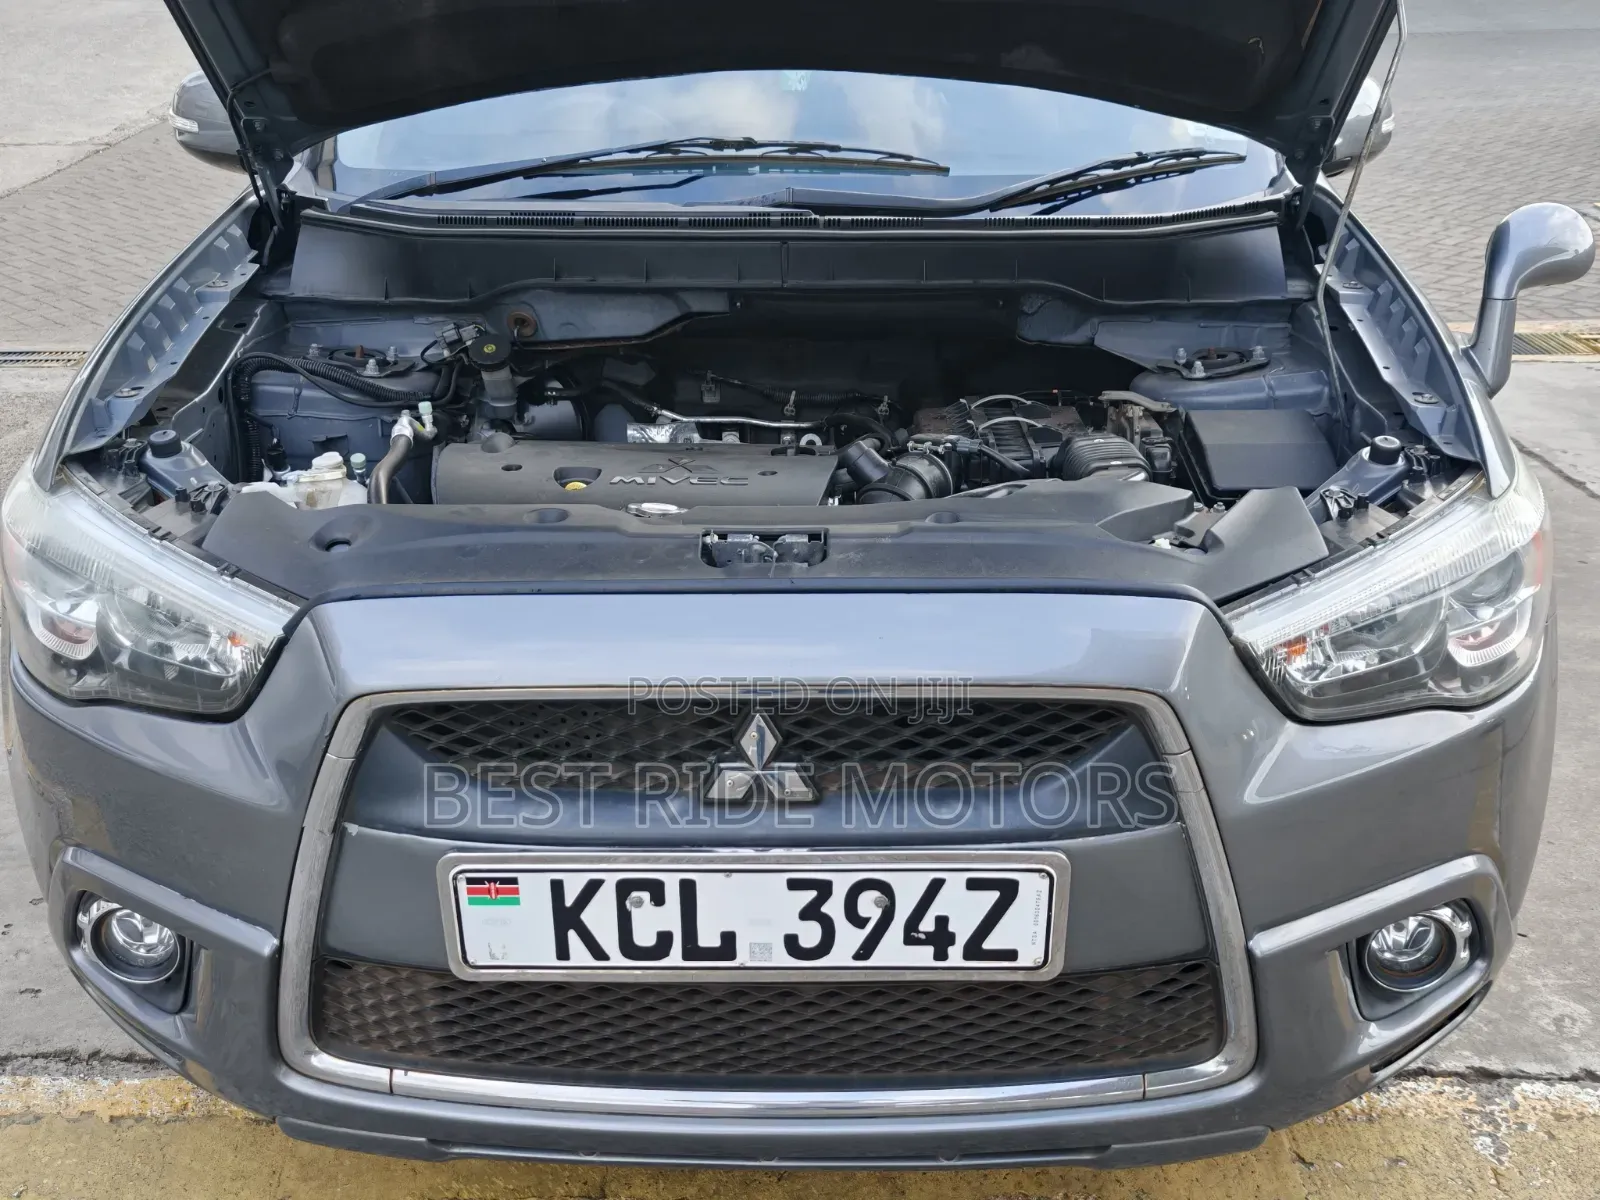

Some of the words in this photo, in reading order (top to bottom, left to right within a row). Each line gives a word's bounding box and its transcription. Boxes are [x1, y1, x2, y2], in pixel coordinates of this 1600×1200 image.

[609, 475, 749, 486] MIVEC
[550, 878, 737, 962] KCL
[783, 877, 1020, 962] 394Z
